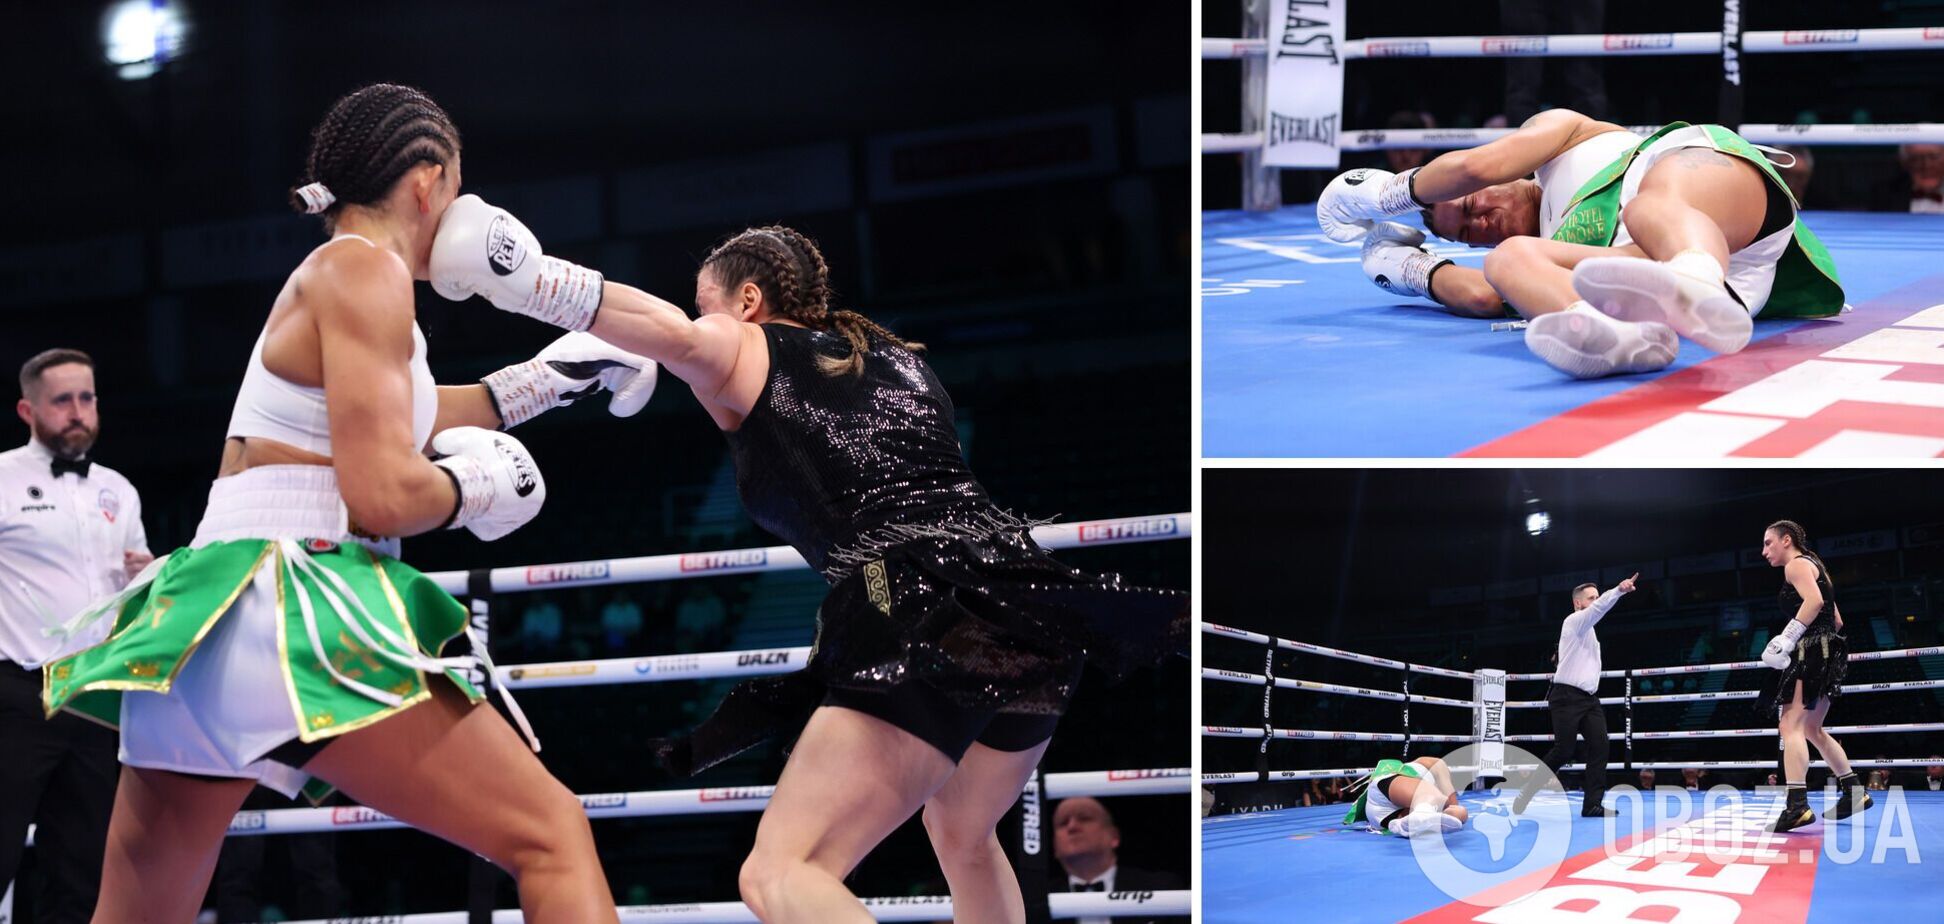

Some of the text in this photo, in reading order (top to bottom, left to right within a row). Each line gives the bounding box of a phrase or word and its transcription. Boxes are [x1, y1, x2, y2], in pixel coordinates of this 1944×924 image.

[1269, 111, 1337, 148] EVERLAST
[1556, 222, 1606, 242] AMORE
[1081, 518, 1175, 542] BETFRED
[681, 550, 766, 572] BETFRED
[528, 561, 610, 586] BETFRED
[737, 651, 789, 667] DAZN
[1483, 700, 1505, 744] EVERLAST
[702, 785, 776, 801] BETFRE
